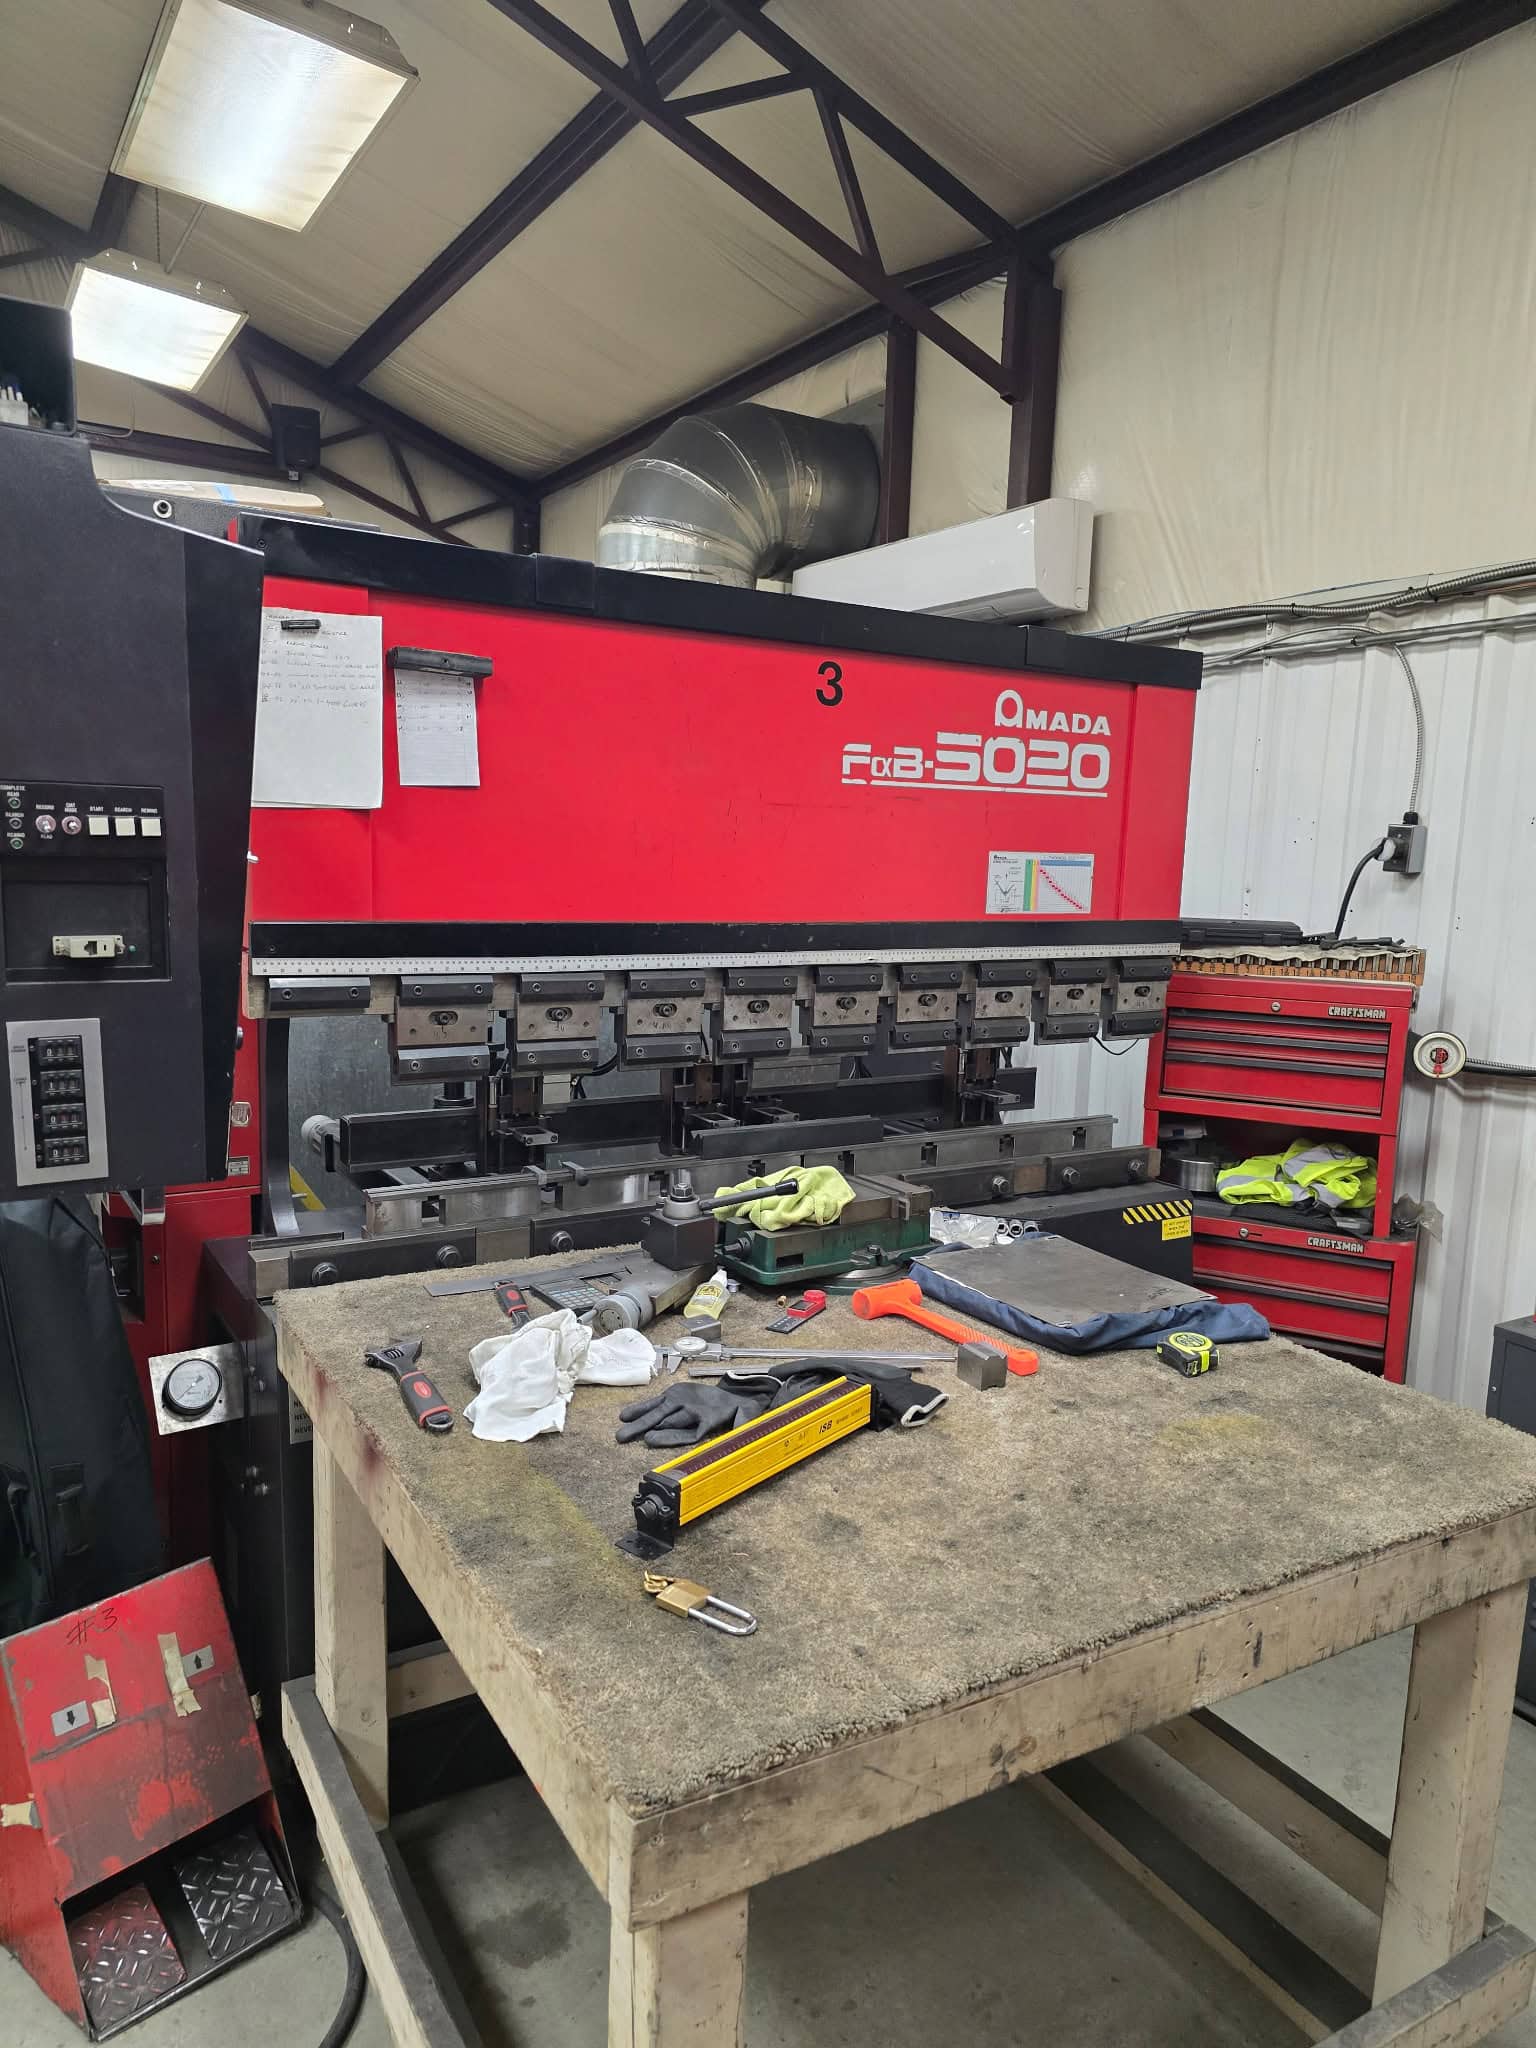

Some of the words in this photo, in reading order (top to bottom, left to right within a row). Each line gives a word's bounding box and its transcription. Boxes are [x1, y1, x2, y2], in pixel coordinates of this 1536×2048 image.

[816, 661, 843, 706] 3
[995, 689, 1111, 735] AMADA
[1328, 1006, 1386, 1020] CRAFTSMAN
[1307, 1236, 1364, 1253] CRAFTSMAN
[66, 1607, 118, 1645] #3
